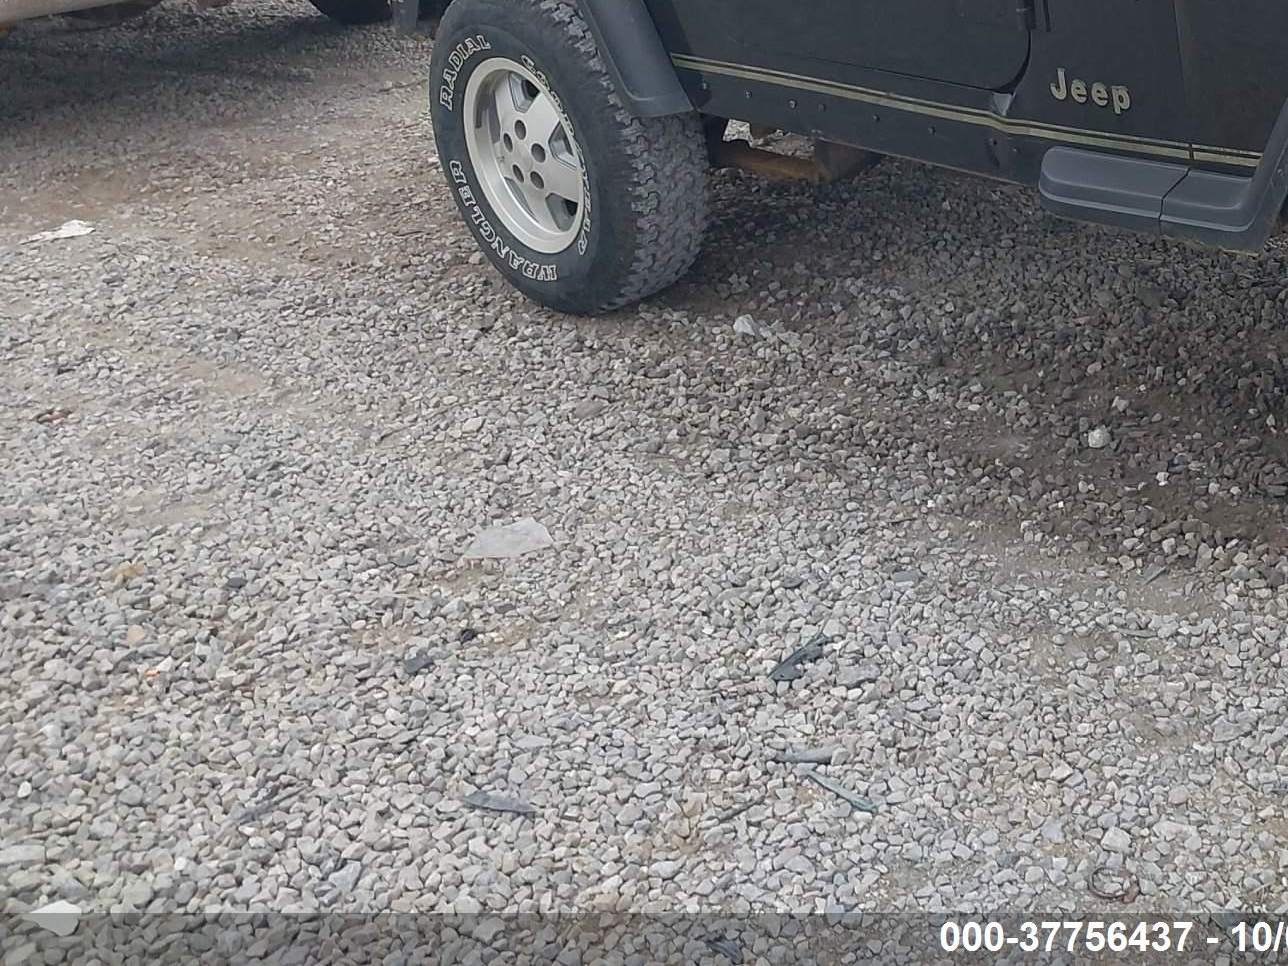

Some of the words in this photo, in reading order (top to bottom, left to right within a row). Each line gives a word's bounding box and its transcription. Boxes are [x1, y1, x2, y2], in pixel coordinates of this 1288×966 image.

[440, 35, 492, 111] RADIAL
[1050, 67, 1131, 115] Jeep
[450, 160, 557, 281] WRANGLER
